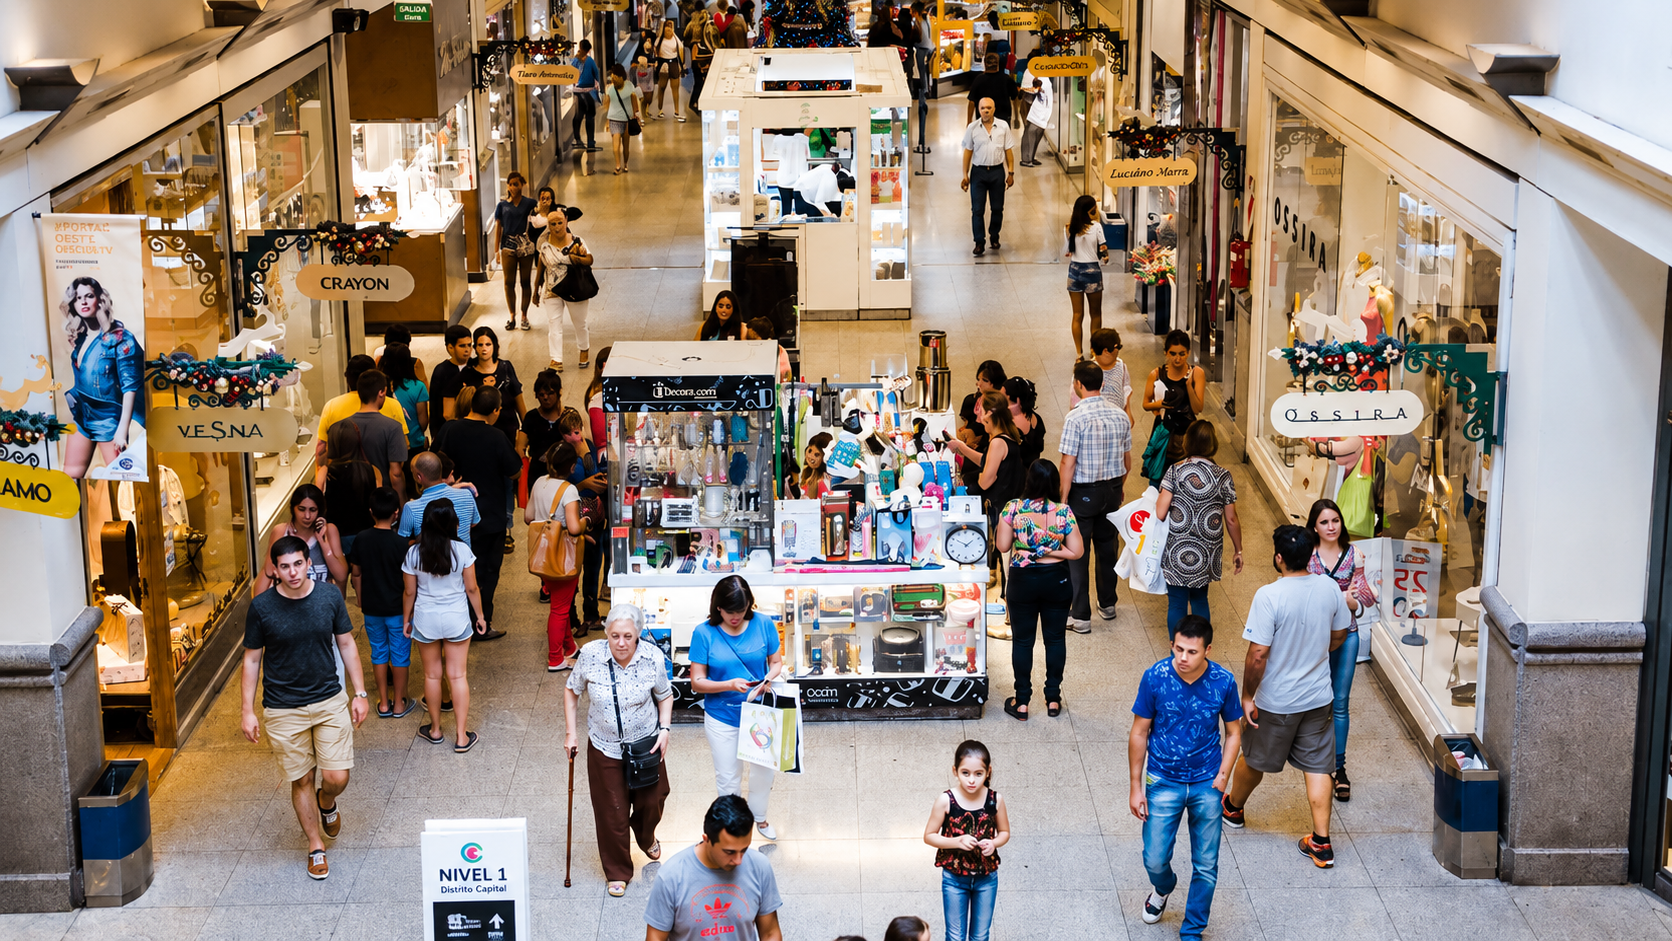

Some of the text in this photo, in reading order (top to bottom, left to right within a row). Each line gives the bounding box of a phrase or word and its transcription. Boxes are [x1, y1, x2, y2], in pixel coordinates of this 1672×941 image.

[1274, 196, 1326, 274] OSSIRA
[320, 276, 389, 291] CRAYON
[177, 420, 263, 442] VESNA
[439, 867, 508, 882] NIVEL 1
